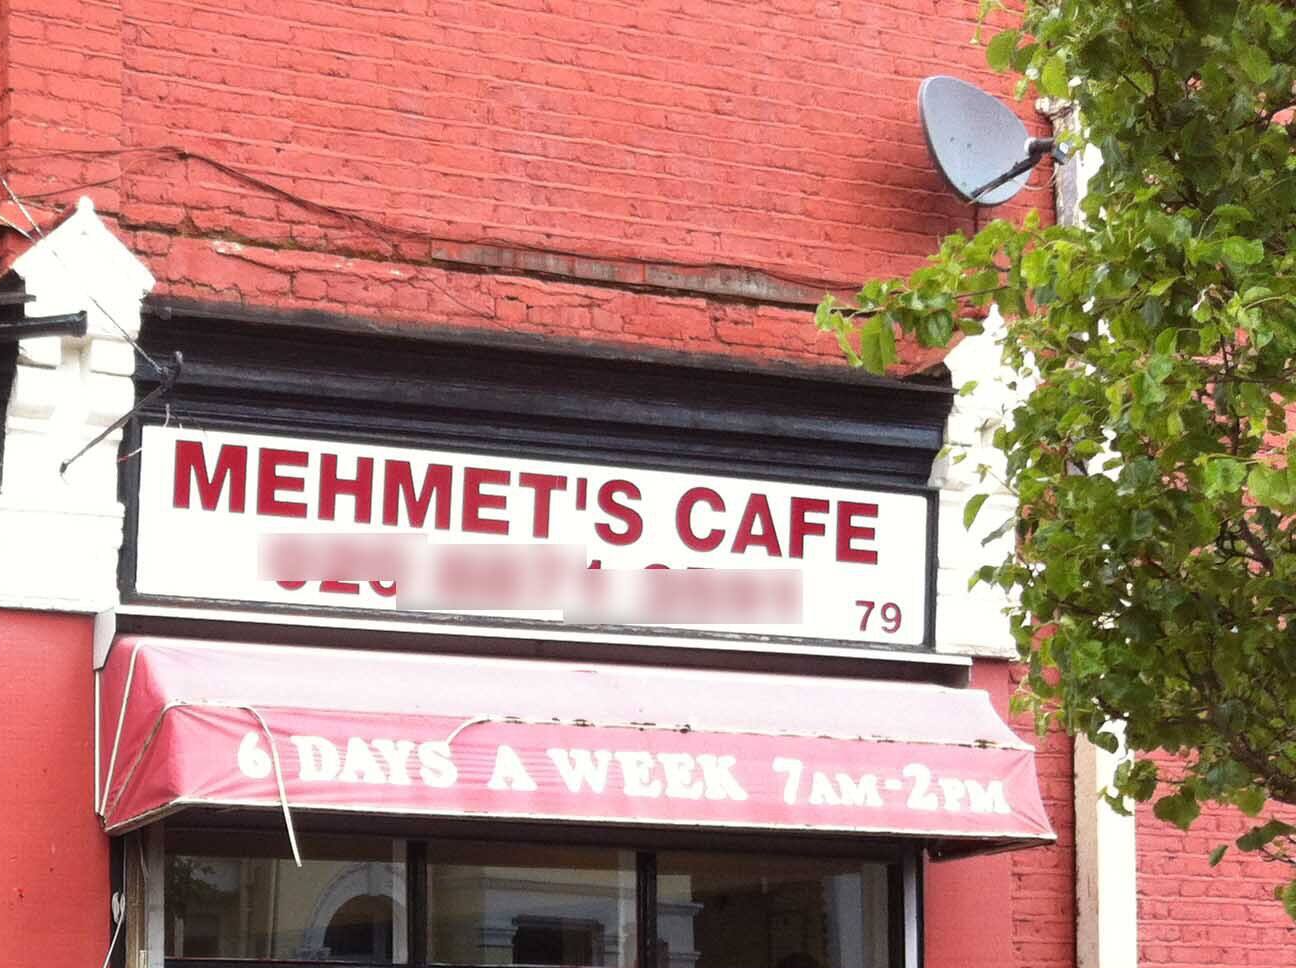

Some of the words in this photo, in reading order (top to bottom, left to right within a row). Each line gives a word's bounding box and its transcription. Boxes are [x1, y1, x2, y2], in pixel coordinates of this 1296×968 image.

[172, 439, 644, 547] MEHMET'S
[675, 487, 879, 565] CAFE
[854, 600, 902, 634] 79
[236, 731, 272, 779] 6
[290, 735, 457, 788] DAYS
[487, 745, 538, 791] A
[546, 747, 749, 802] WEEK
